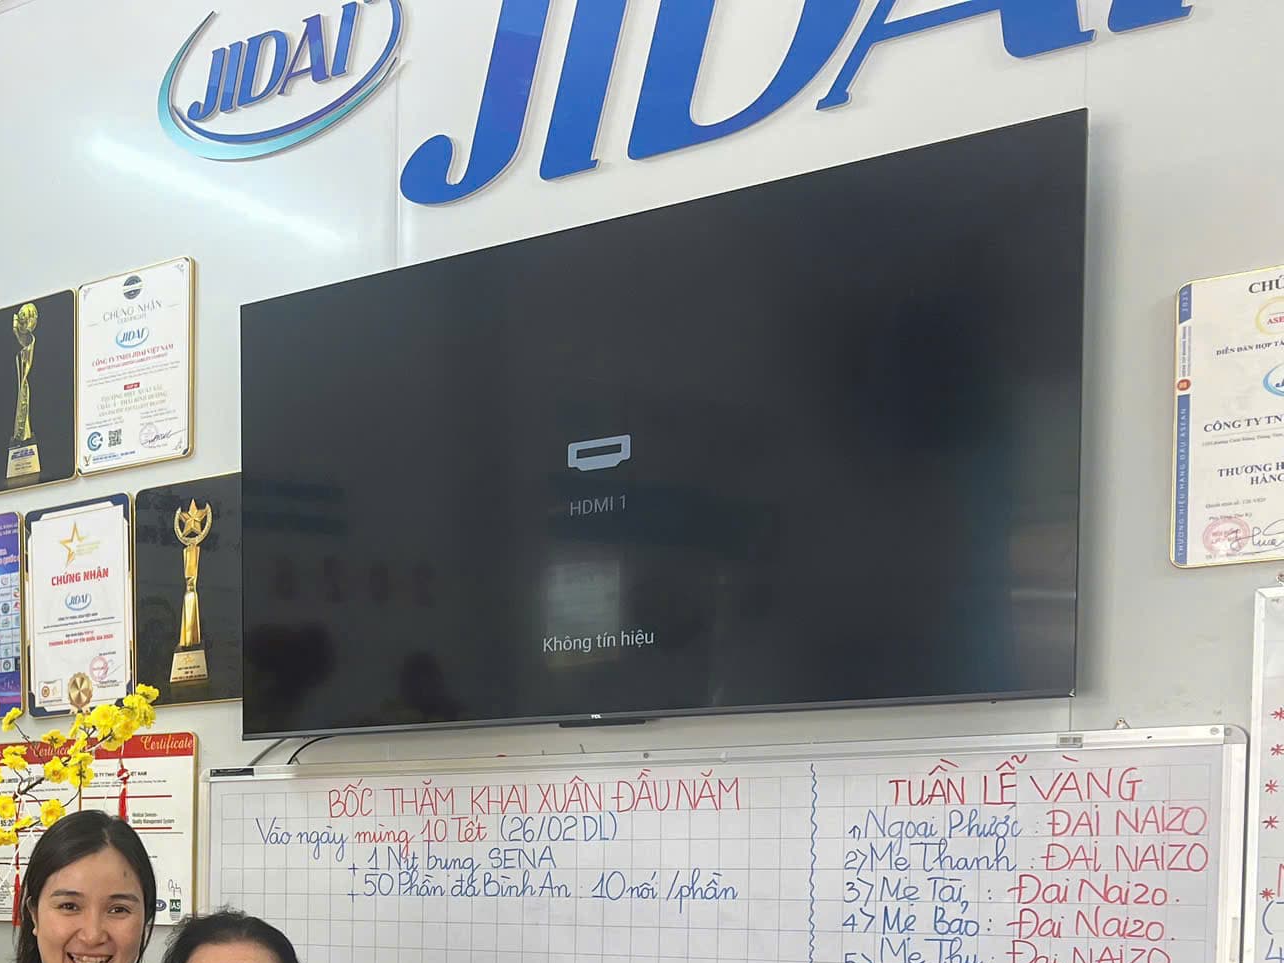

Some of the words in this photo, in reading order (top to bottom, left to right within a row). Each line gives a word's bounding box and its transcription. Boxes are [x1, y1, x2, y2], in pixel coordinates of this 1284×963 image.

[187, 2, 358, 121] JIDAI
[570, 496, 613, 516] HDMI
[619, 495, 626, 509] 1
[51, 572, 81, 586] CHỨNG
[83, 566, 109, 581] NHẬN
[543, 636, 592, 653] Không
[596, 632, 616, 648] tín
[621, 629, 654, 648] hiệu
[140, 734, 193, 754] Certificate
[328, 778, 373, 818] BỐC
[383, 779, 455, 816] THĂM
[470, 784, 527, 816] KHAI
[537, 775, 602, 814] XUÂN
[611, 768, 670, 813] ĐẦU
[675, 769, 740, 812] NĂM
[888, 758, 965, 806] TUẦN
[983, 754, 1027, 805] LỄ
[1029, 755, 1143, 802] VÀNG
[1116, 800, 1207, 836] NAIZO
[255, 817, 293, 845] Vào
[296, 825, 348, 862] ngày
[420, 818, 447, 842] 10
[450, 815, 487, 843] Tết
[488, 846, 557, 869] SENA
[909, 837, 1017, 873] Thanh
[1115, 841, 1209, 872] NAIZO
[538, 871, 571, 898] An
